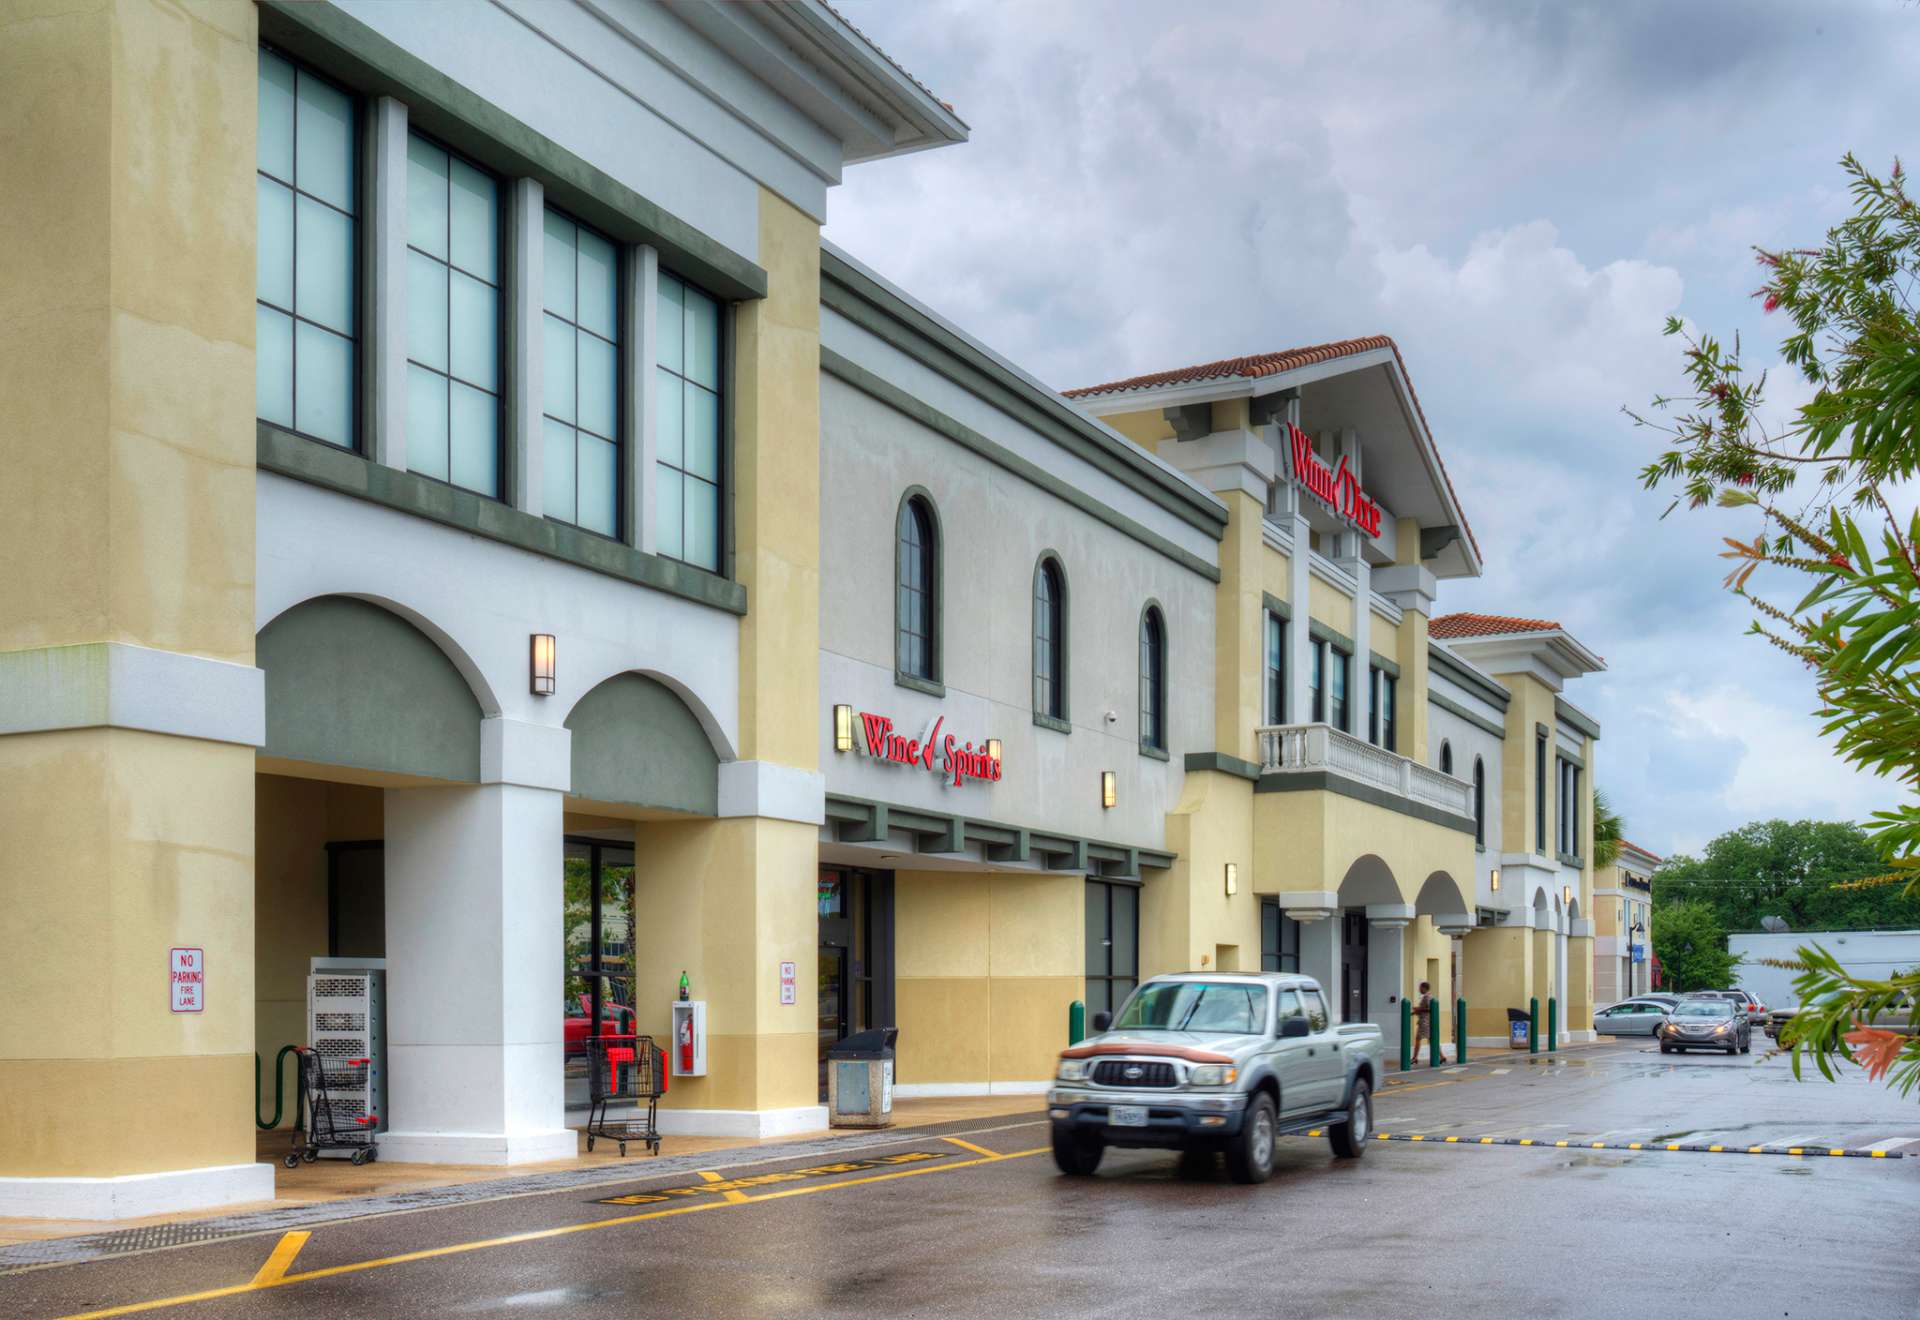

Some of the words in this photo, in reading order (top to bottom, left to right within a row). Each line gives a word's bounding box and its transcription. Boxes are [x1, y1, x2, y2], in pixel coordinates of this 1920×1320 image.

[1286, 421, 1333, 504] Winn
[1343, 471, 1381, 539] Dixie
[860, 712, 920, 766] Wine
[944, 734, 1001, 787] Spirits
[180, 954, 194, 967] NO
[172, 971, 202, 984] PARKING
[180, 985, 194, 995] FIRE
[179, 996, 195, 1006] LANE
